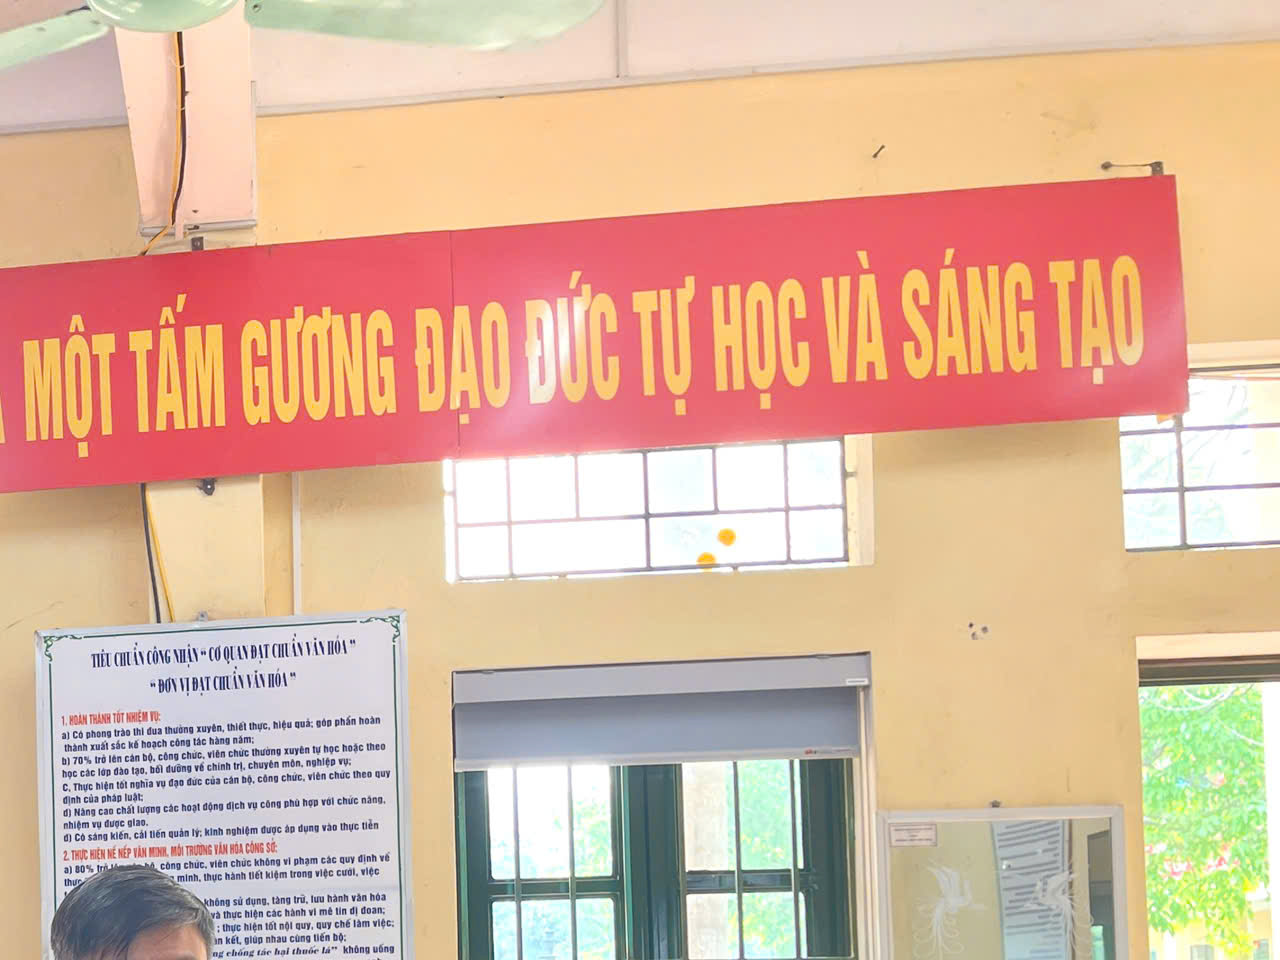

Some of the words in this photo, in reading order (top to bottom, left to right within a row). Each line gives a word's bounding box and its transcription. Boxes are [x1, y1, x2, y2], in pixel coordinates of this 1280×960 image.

[23, 314, 116, 458] MỘT
[129, 293, 226, 433] TẤM
[240, 305, 397, 426] GƯƠNG
[415, 301, 511, 425] ĐẠO
[525, 271, 619, 404] ĐỨC
[632, 275, 696, 416] TỰ
[711, 278, 811, 410] HỌC
[821, 250, 888, 384] VÀ
[901, 248, 1038, 379] SÁNG
[1048, 255, 1145, 386] TẠO
